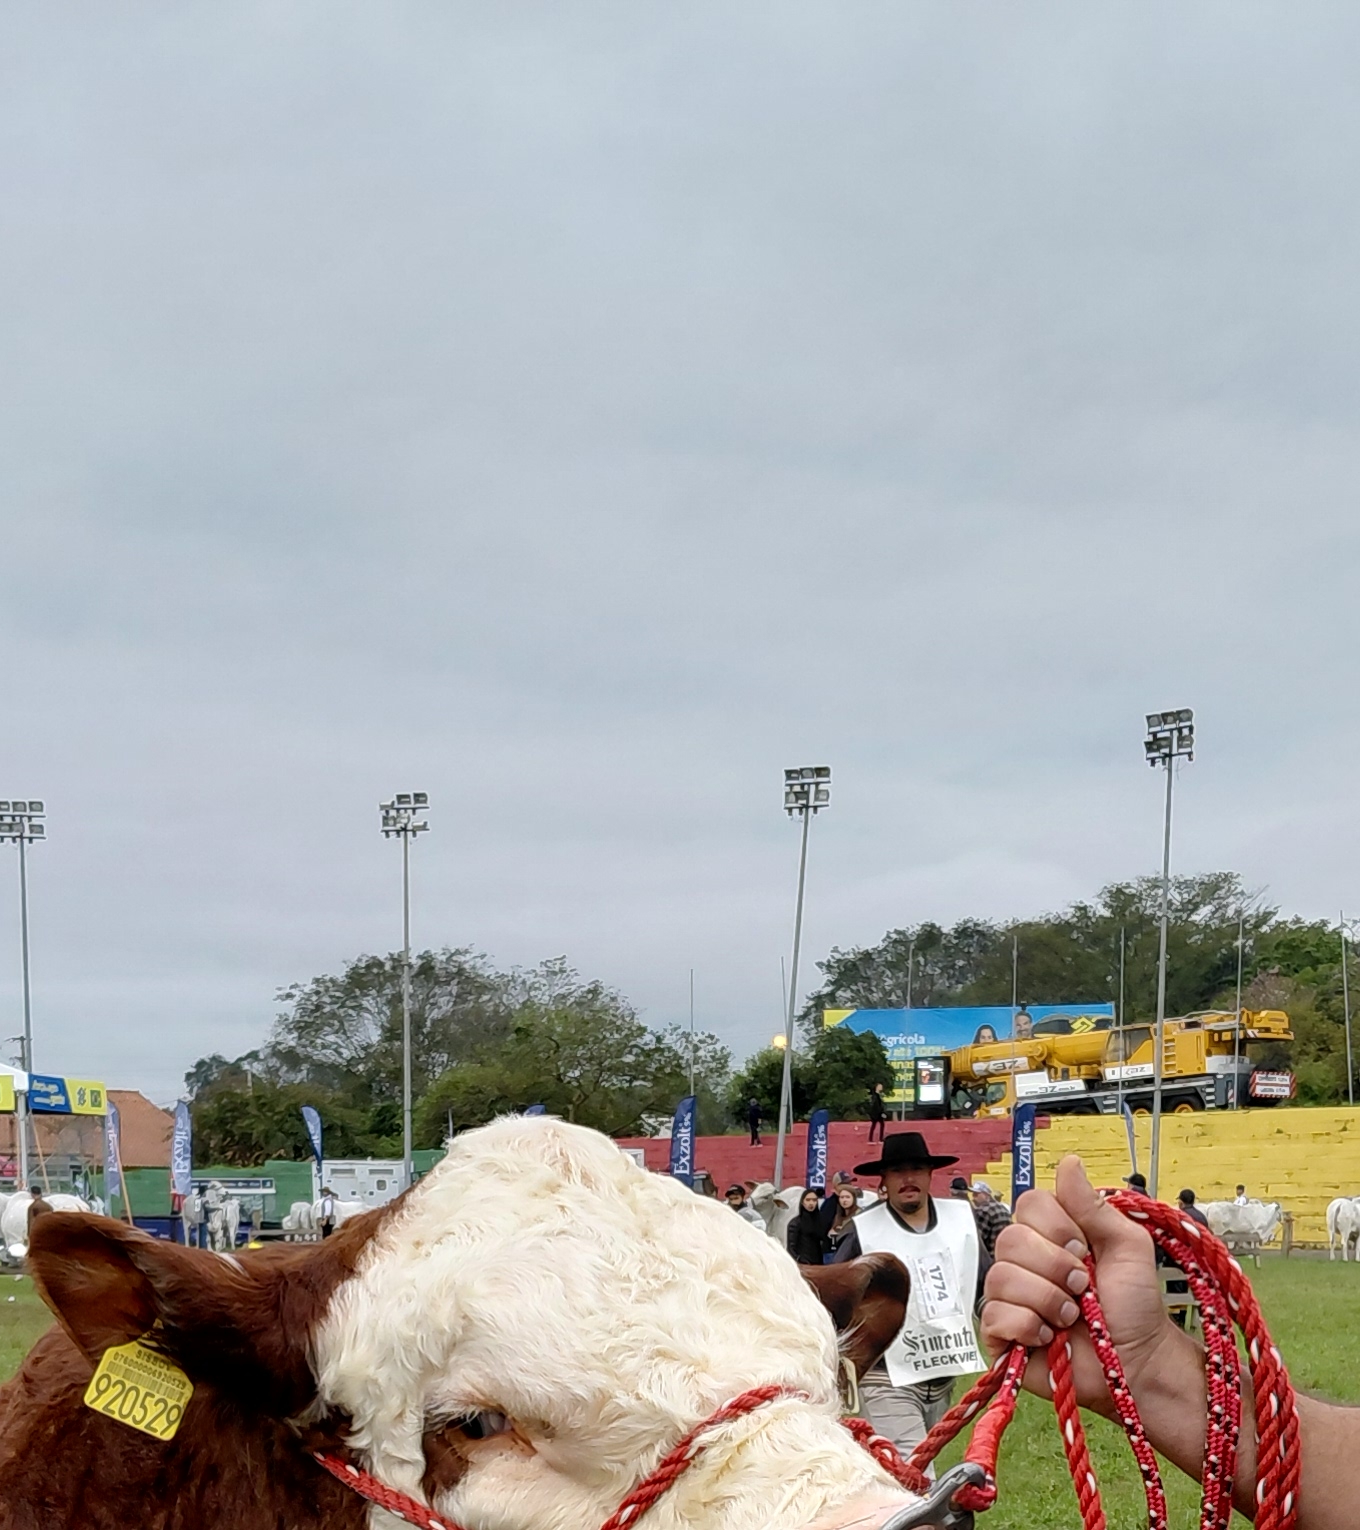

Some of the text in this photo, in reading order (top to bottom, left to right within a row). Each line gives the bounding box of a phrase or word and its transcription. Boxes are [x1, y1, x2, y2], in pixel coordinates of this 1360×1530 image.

[674, 1126, 692, 1176] Exzolt
[809, 1137, 827, 1189] Exzolt
[1015, 1135, 1032, 1187] Exzolt
[929, 1265, 950, 1302] 1774
[913, 1350, 978, 1372] FLECKVIE
[88, 1373, 182, 1436] 920529
